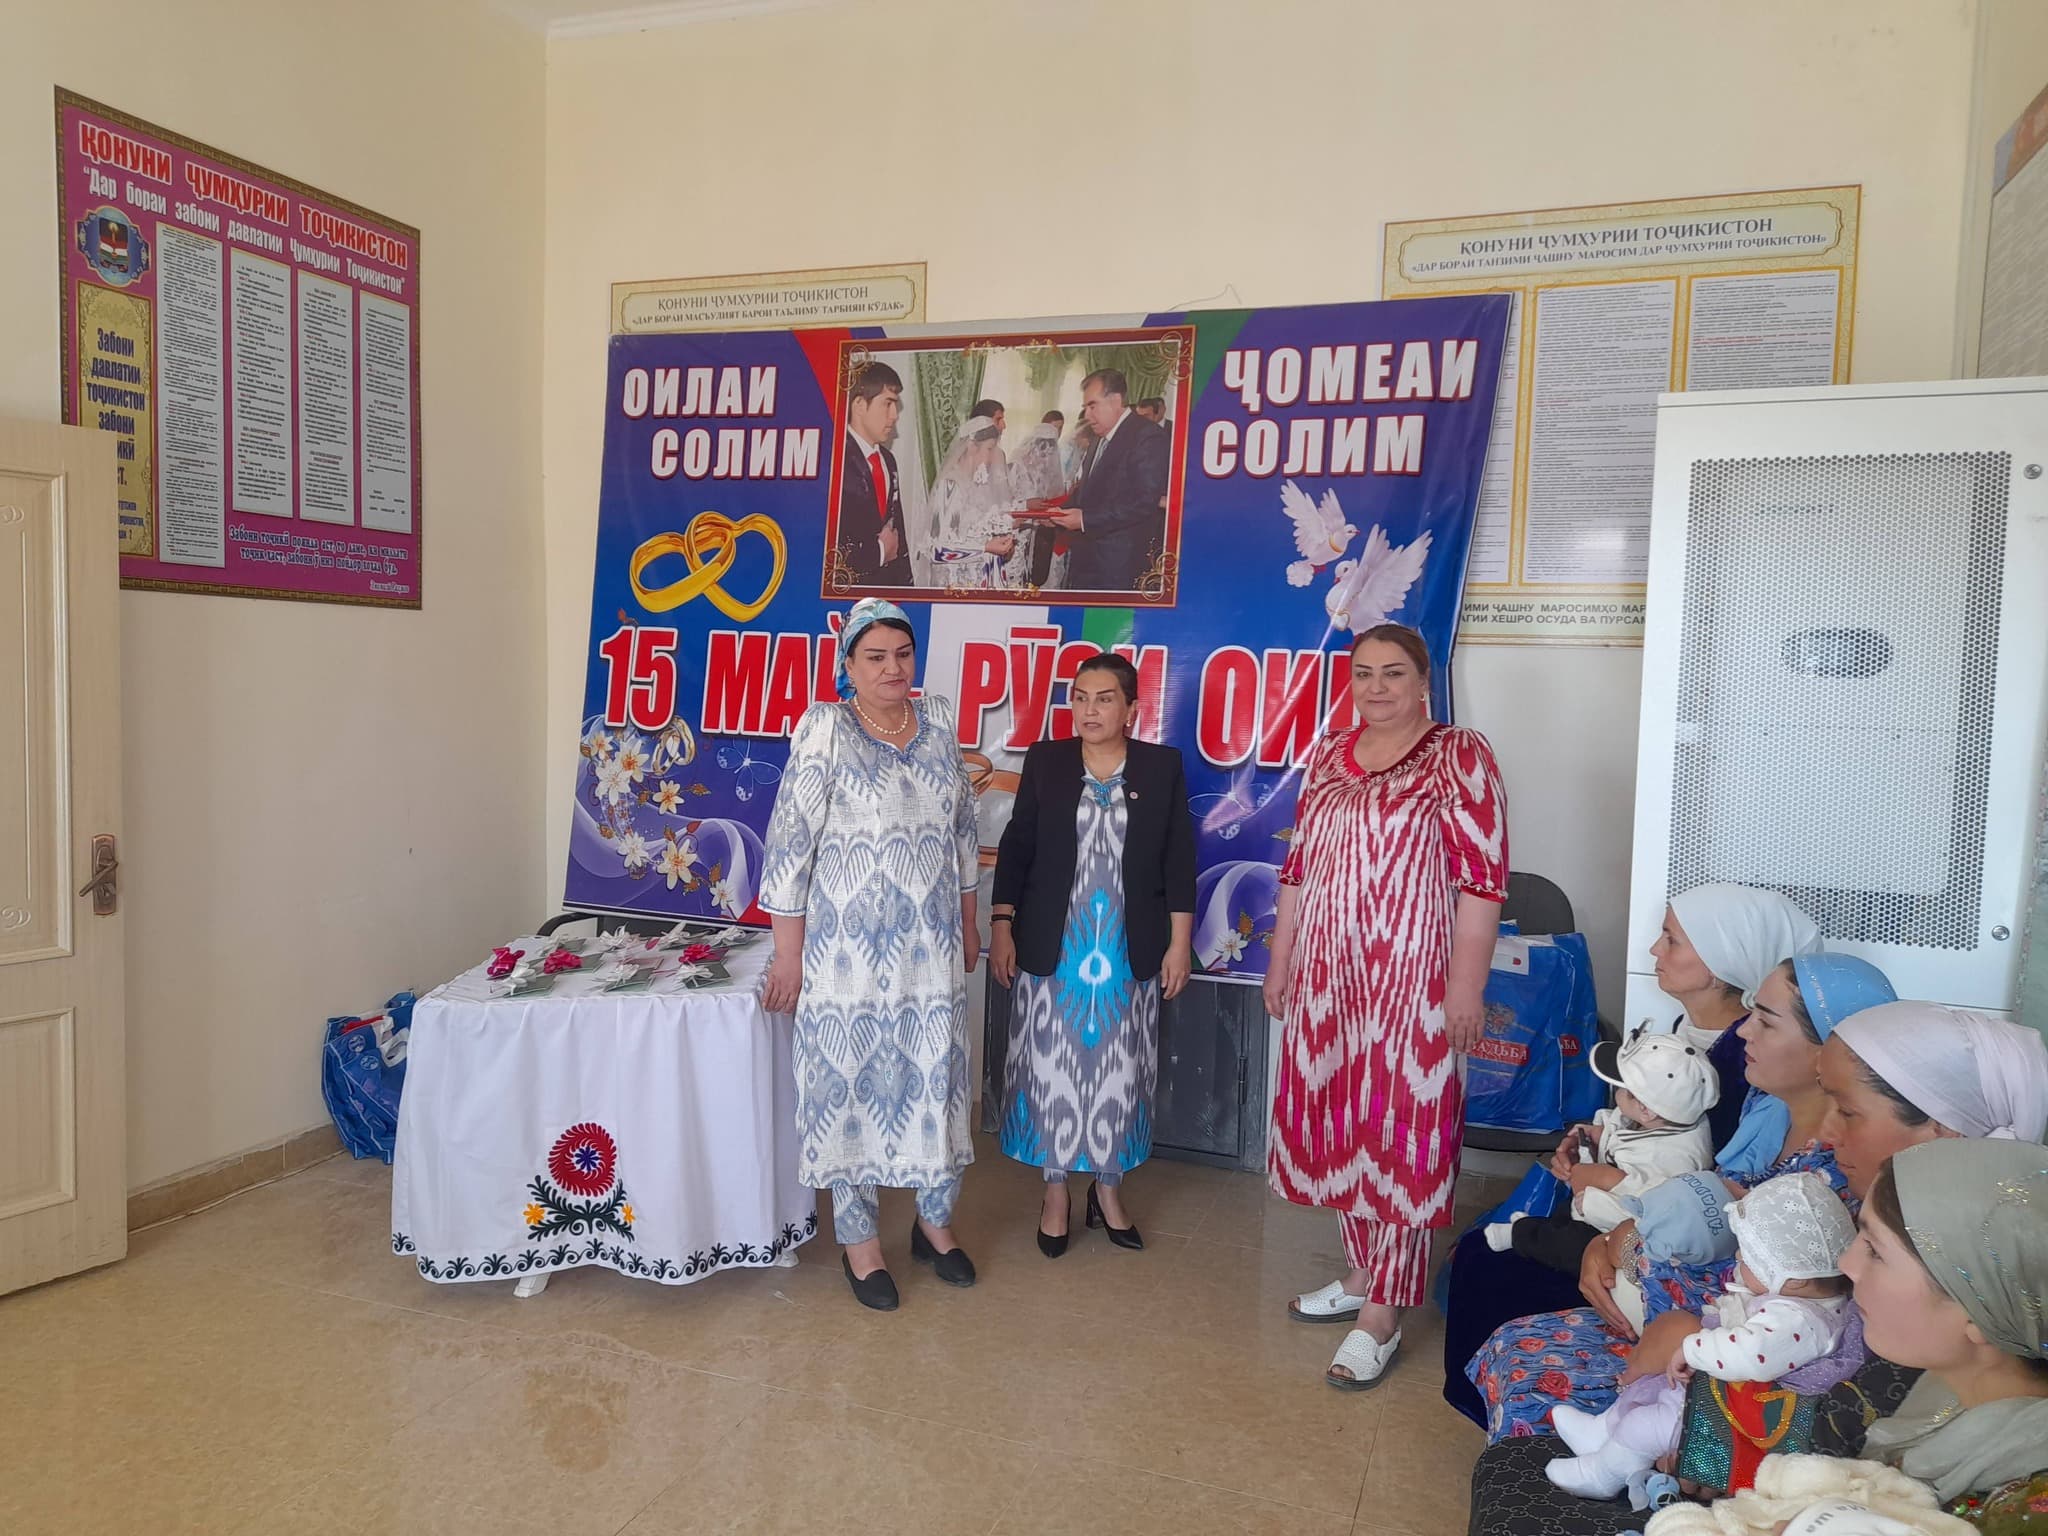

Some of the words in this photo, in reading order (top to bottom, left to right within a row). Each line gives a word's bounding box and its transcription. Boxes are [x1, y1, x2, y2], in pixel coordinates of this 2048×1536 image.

[80, 121, 172, 185] ҚОНУНИ
[185, 161, 289, 227] ҶУМҲУРИИ
[300, 204, 407, 270] ТОҶИКИСТОН
[126, 181, 167, 215] бораи
[175, 202, 219, 233] забони
[227, 220, 283, 254] давлатии
[1460, 237, 1533, 256] ҚОНУНИ
[1539, 227, 1638, 250] ҶУМҲУРИИ
[1643, 218, 1772, 241] ТОҶИКИСТОН
[1439, 259, 1475, 271] БОРАИ
[1478, 256, 1531, 268] ТАНЗИМИ
[1579, 247, 1637, 260] МАРОСИМ
[1639, 246, 1662, 258] ДАР
[654, 313, 683, 324] БОРАИ
[742, 308, 773, 319] БАРОИ
[822, 302, 866, 314] ТАРБИЯИ
[658, 296, 707, 312] ҚОНУНИ
[711, 292, 779, 308] ҶУМҲУРИИ
[783, 286, 868, 304] ТОҶИКИСТОН
[97, 328, 134, 358] Забони
[91, 357, 141, 385] давлатии
[1223, 339, 1479, 415] ҶОМЕАИ
[622, 366, 777, 419] ОИЛАИ
[98, 410, 135, 435] забони
[650, 428, 822, 480] СОЛИМ
[1202, 415, 1426, 479] СОЛИМ
[1491, 614, 1534, 624] ХЕШРО
[1536, 615, 1577, 625] ОСУДА
[1580, 616, 1597, 625] ВА
[1540, 603, 1618, 615] МАРОСИМҲО
[600, 626, 678, 731] 15
